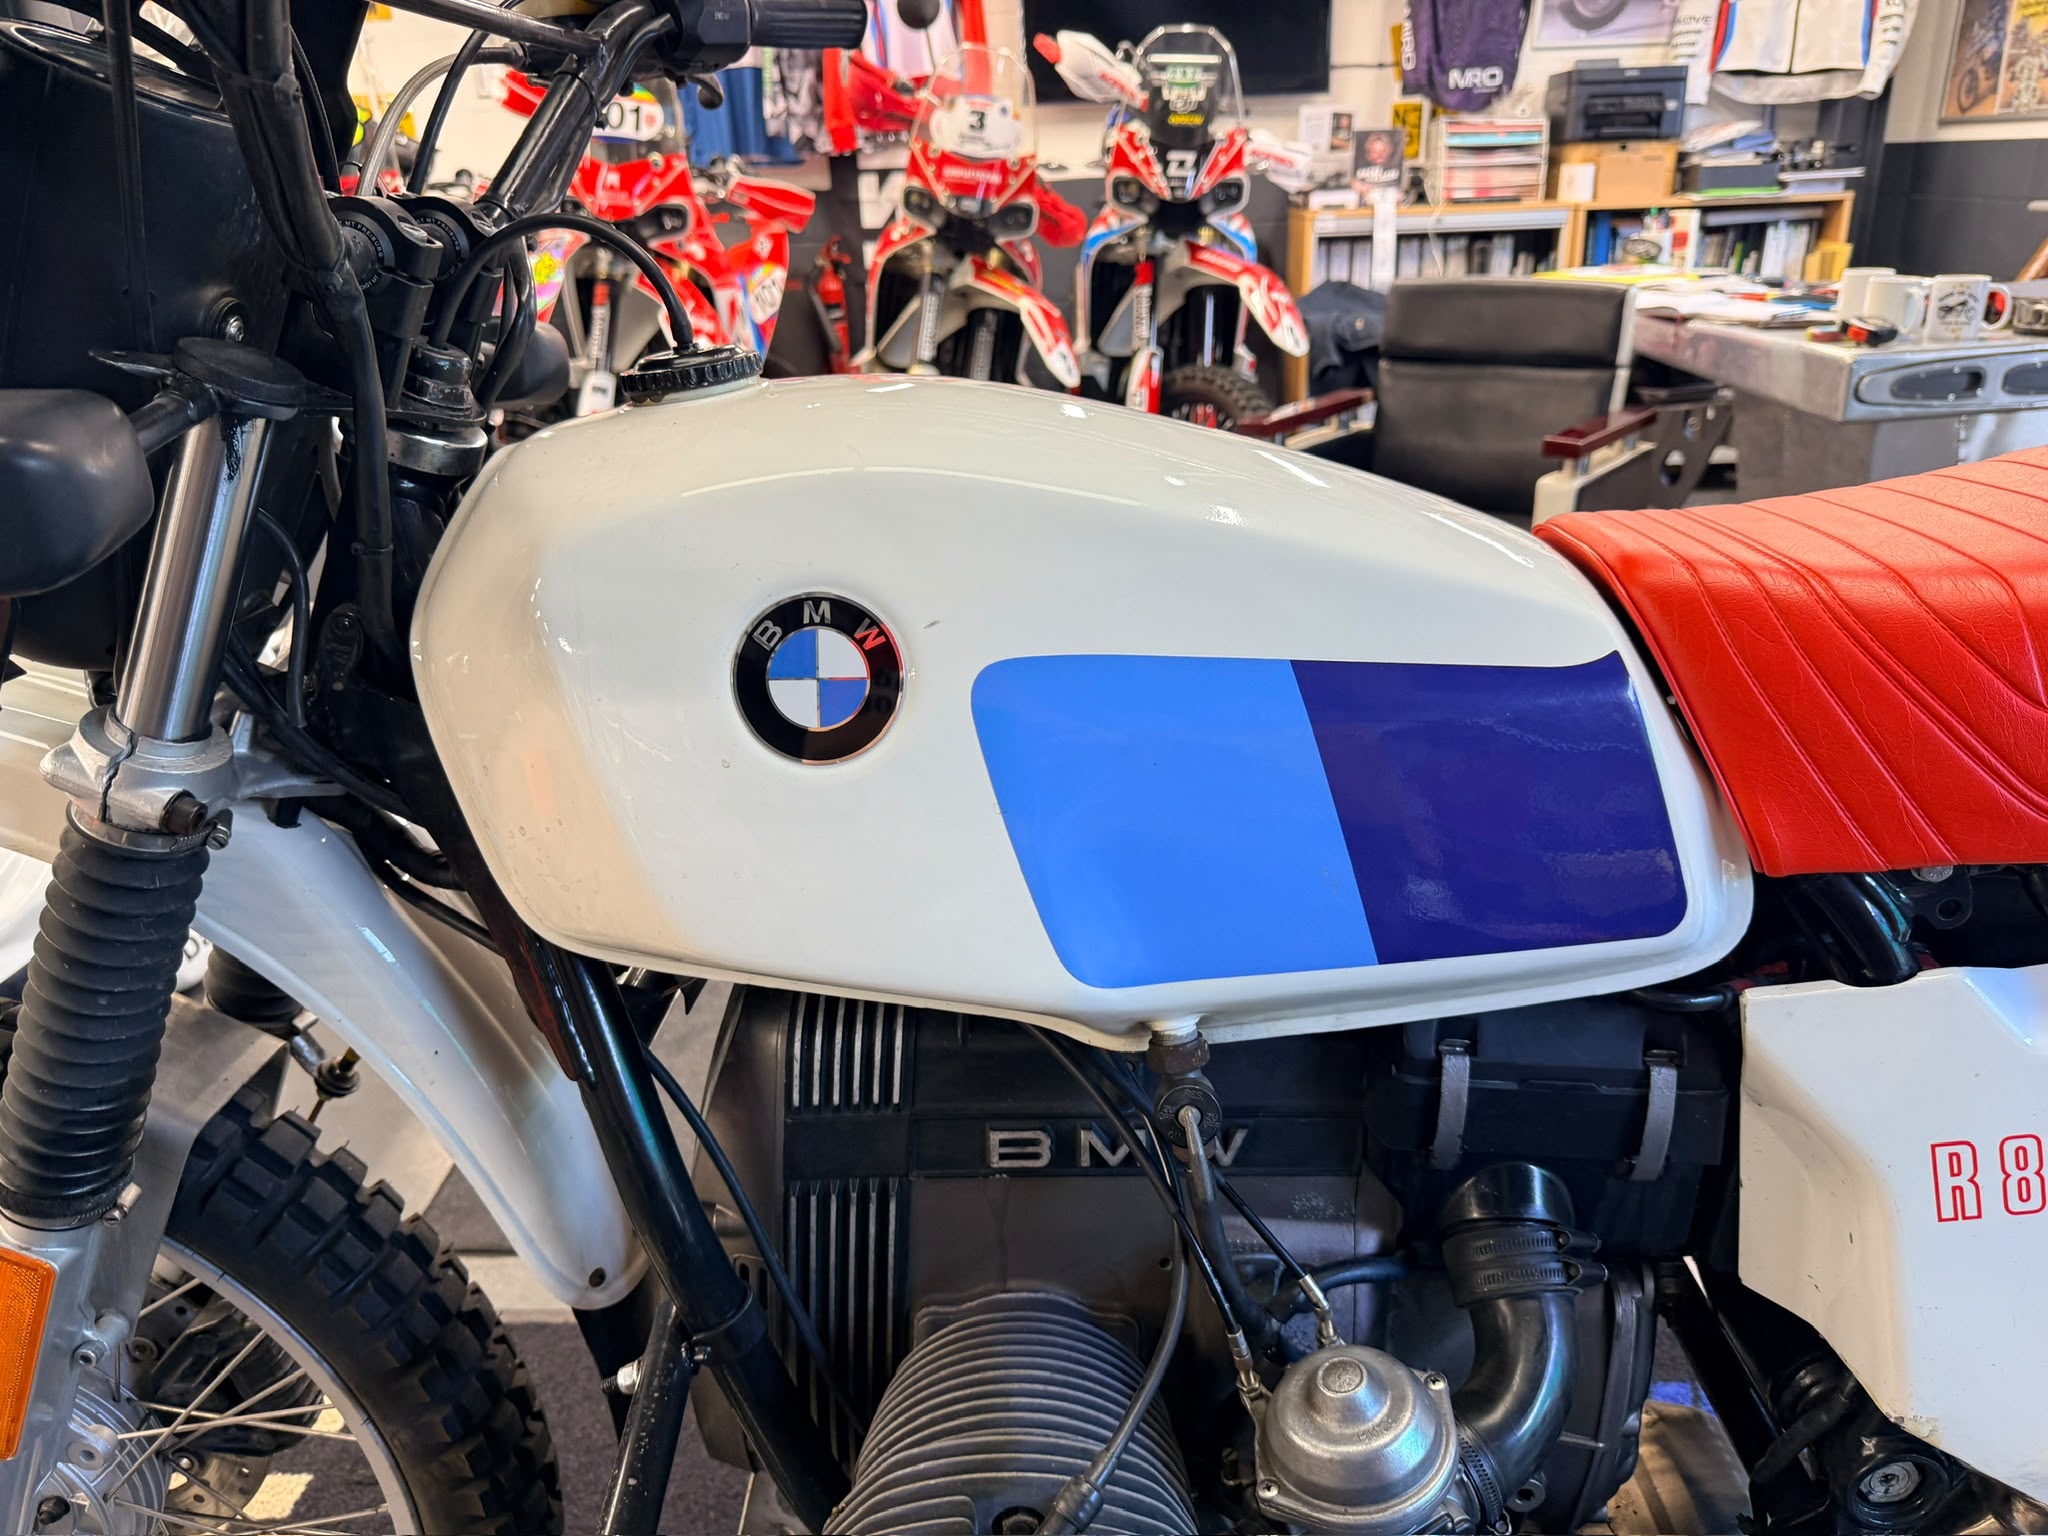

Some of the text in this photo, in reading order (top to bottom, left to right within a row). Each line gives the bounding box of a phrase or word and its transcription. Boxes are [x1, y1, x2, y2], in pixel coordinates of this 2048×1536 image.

[1448, 65, 1505, 91] MRO
[968, 110, 986, 130] 3
[357, 223, 385, 258] FREIBURG
[752, 600, 887, 651] BMW
[987, 1124, 1249, 1169] BMW
[1930, 1140, 1983, 1223] R
